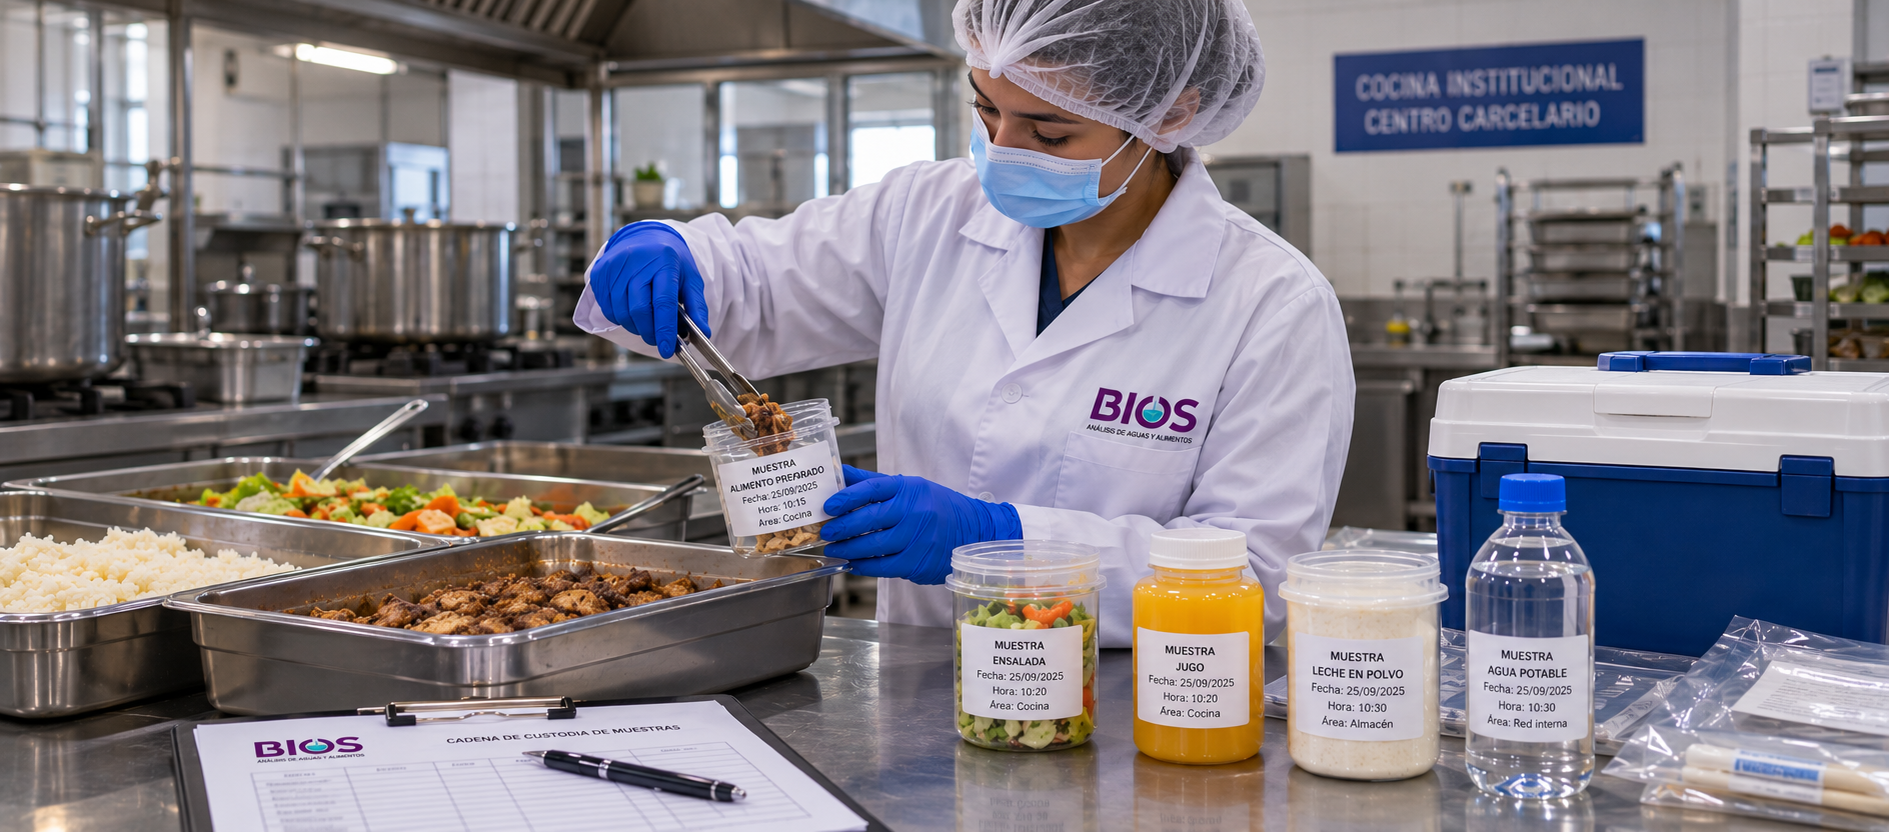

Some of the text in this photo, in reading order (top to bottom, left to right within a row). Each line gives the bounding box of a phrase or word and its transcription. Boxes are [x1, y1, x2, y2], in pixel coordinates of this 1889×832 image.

[1355, 63, 1623, 101] COCINA INSTITUCIONAL
[1364, 99, 1601, 135] CENTRO CARCELARIO
[1090, 387, 1200, 433] BIOS
[1116, 428, 1126, 437] DE
[1127, 430, 1149, 440] AGUAS
[1150, 433, 1156, 441] Y
[751, 459, 797, 475] MUESTRA
[730, 478, 774, 493] ALIMENTO
[742, 481, 818, 504] Fecha: 25/09/2025
[757, 497, 807, 514] Hora: 10:15
[782, 510, 812, 523] Cocina
[994, 640, 1045, 650] MUESTRA
[1165, 645, 1216, 656] MUESTRA
[993, 656, 1046, 666] ENSALADA
[1330, 651, 1385, 662] MUESTRA
[1501, 650, 1554, 661] MUESTRA
[1175, 662, 1205, 672] JUGO
[1312, 666, 1404, 679] LECHE EN POLVO
[1487, 665, 1568, 679] AGUA POTABLE
[976, 670, 1064, 682] Fecha: 25/09/2025
[1148, 674, 1235, 688] Fecha: 25/09/2025
[992, 686, 1047, 696] Hora: 10:20
[1311, 682, 1405, 696] Fecha: 25/09/2025
[1483, 682, 1572, 696] Fecha: 25/09/2025
[1163, 692, 1218, 703] Hora: 10:20
[989, 700, 1050, 711] Área: Cocina
[1160, 706, 1221, 718] Área: Cocina
[1328, 701, 1387, 713] Hora: 10:30
[1498, 700, 1556, 712] Hora: 10:30
[1322, 716, 1394, 729] Área: Almacén
[1487, 714, 1568, 729] Área: Red interna
[446, 735, 500, 744] CADENA
[524, 731, 590, 740] CUSTODIA
[592, 728, 610, 736] DE
[612, 724, 681, 734] MUESTRAS
[254, 736, 364, 758] BIOS
